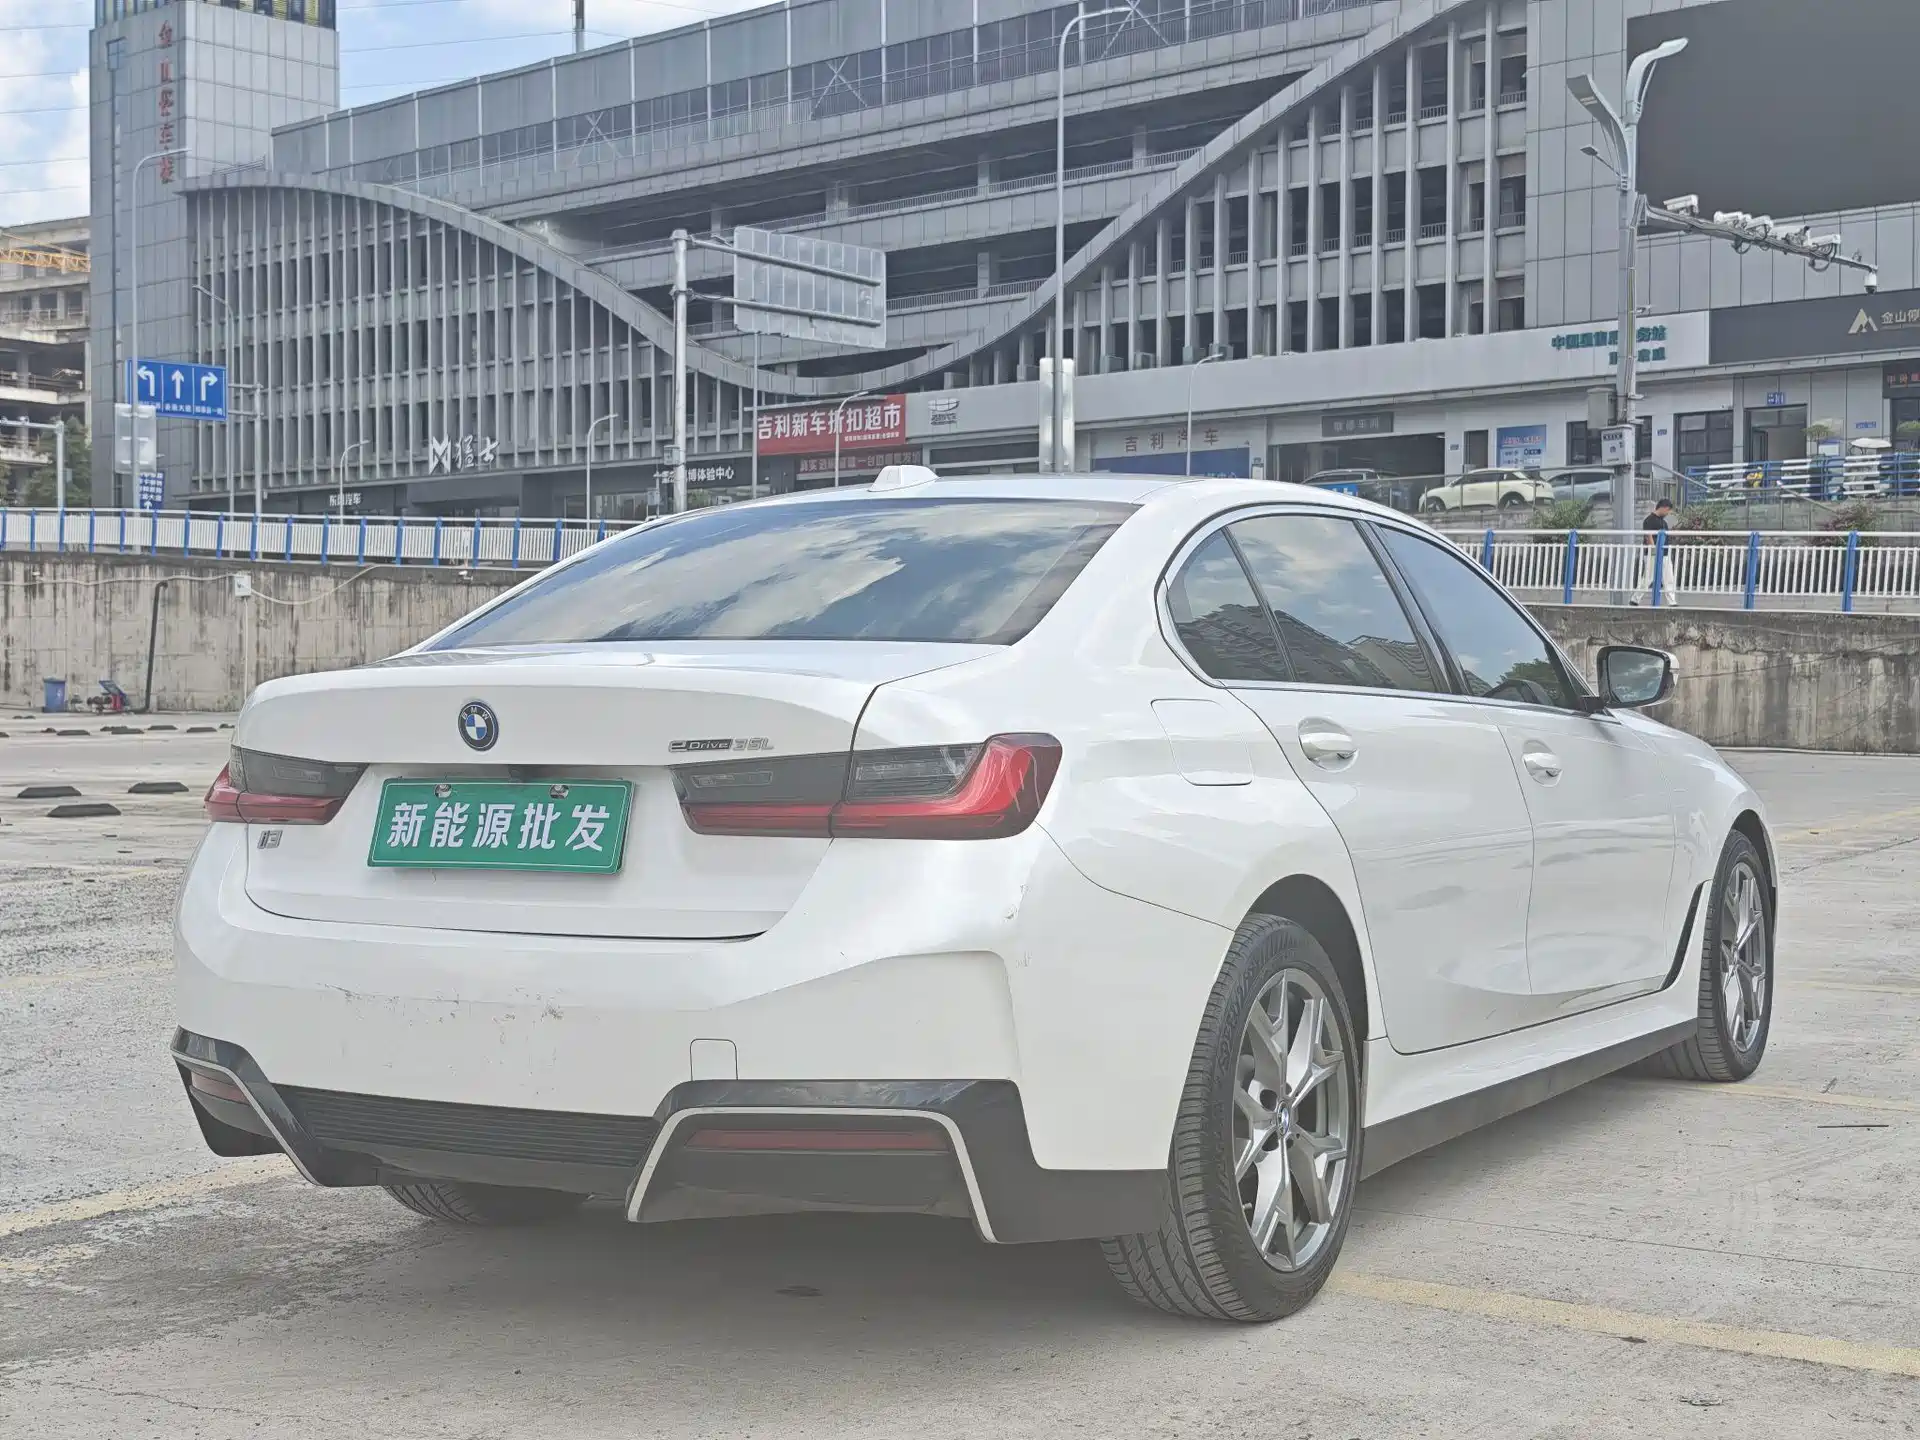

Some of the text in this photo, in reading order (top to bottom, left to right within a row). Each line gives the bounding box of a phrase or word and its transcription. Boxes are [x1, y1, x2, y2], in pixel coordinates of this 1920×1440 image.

[757, 403, 901, 441] 吉利新车折扣超市
[386, 801, 610, 852] 新能源批发
